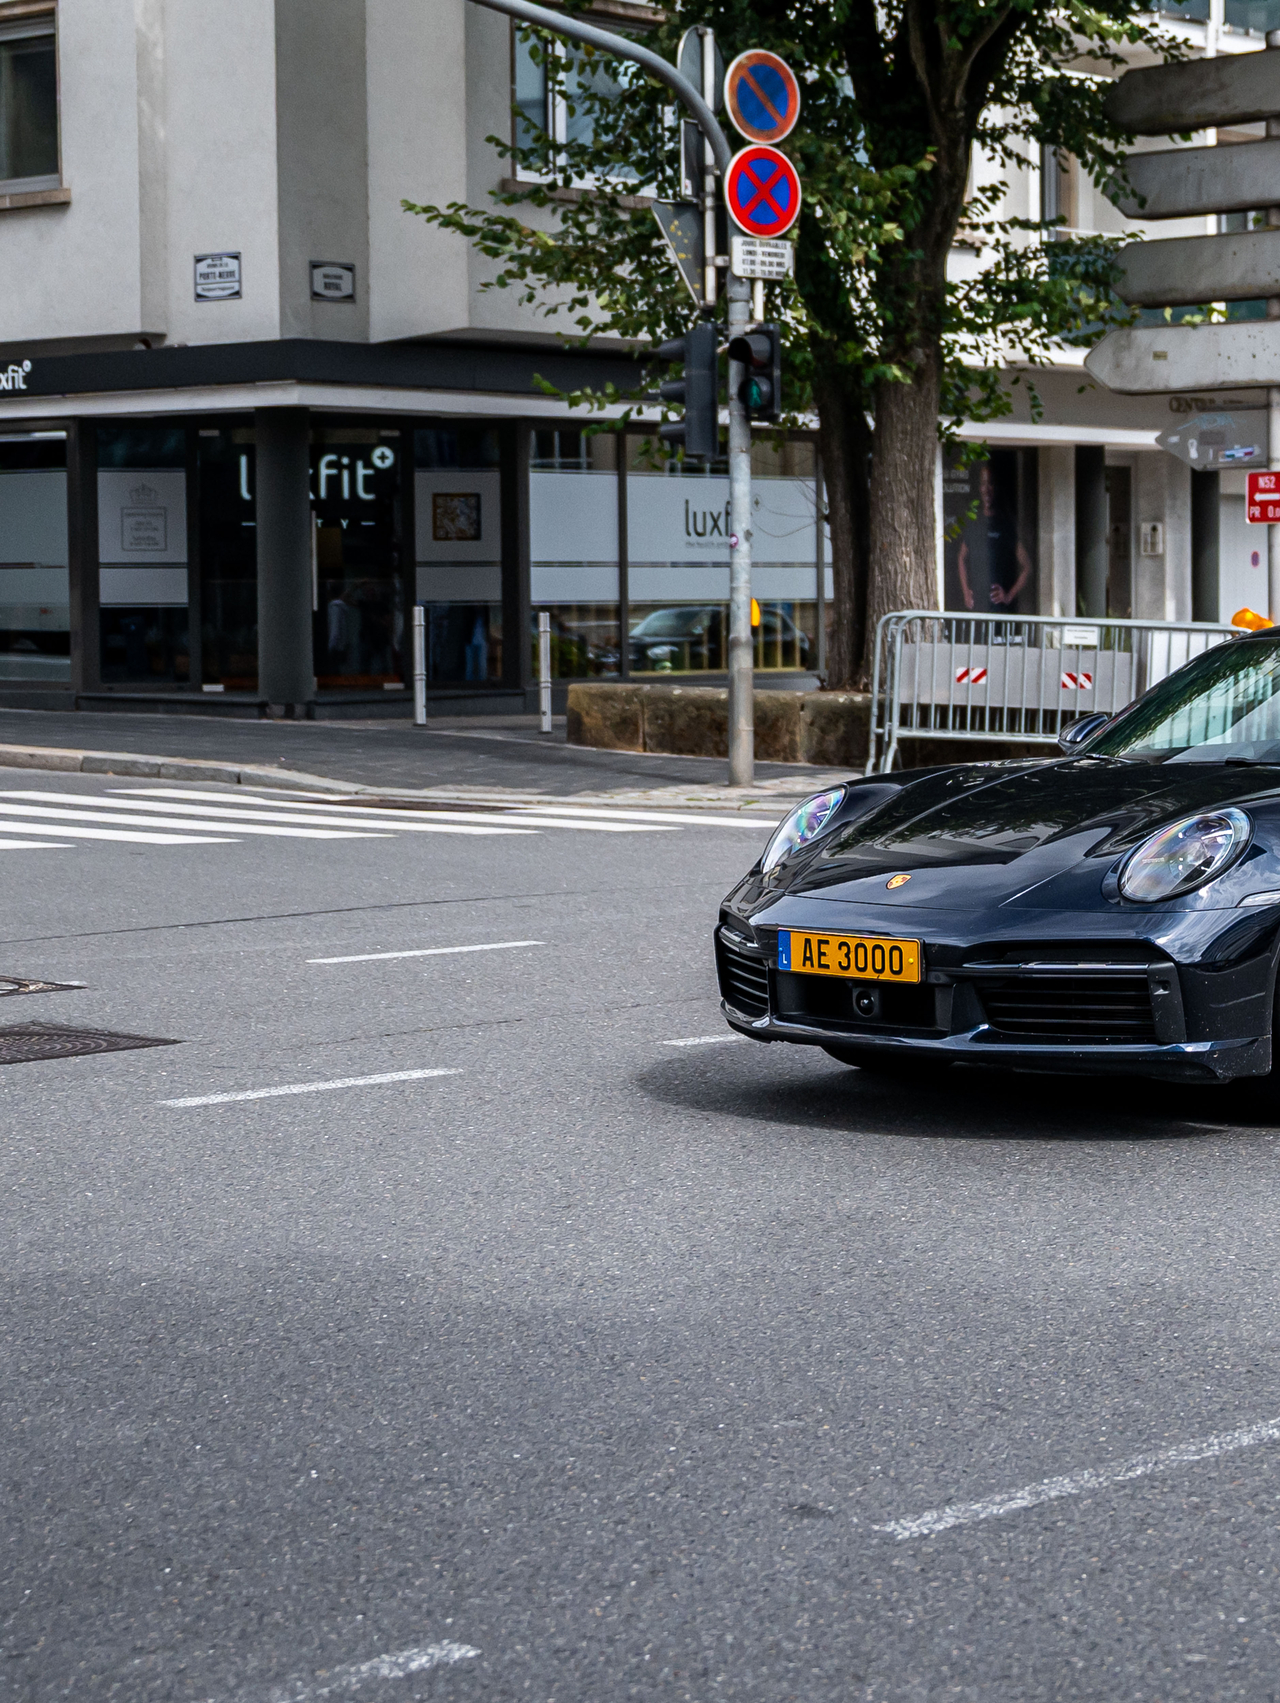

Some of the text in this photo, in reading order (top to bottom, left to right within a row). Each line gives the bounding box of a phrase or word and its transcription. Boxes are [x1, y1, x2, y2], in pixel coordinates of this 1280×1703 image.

[1258, 476, 1276, 489] N52
[1250, 506, 1261, 518] PR
[782, 953, 788, 965] L
[802, 937, 903, 975] AE 3000
